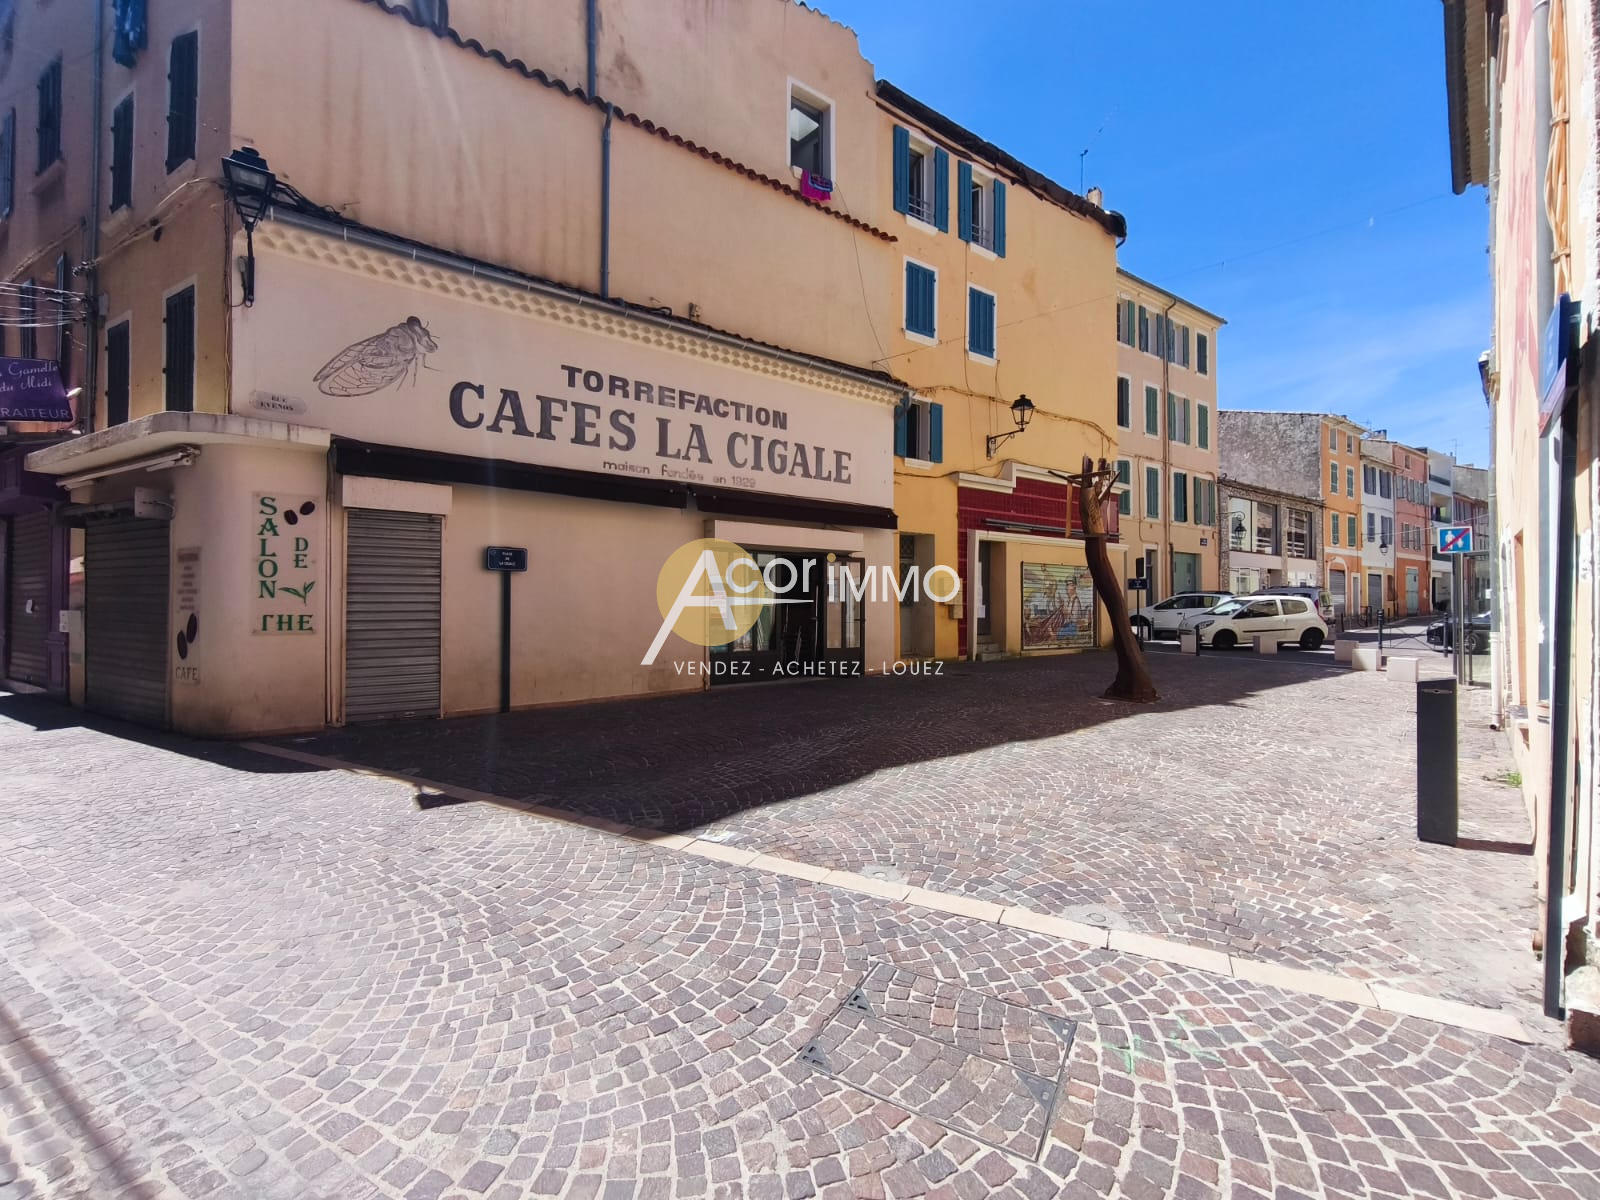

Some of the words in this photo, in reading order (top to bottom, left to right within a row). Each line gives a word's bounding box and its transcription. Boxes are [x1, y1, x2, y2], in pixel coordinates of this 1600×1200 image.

[20, 375, 52, 390] Midi
[560, 364, 788, 431] TORREFACTION
[0, 407, 70, 419] RAITEUR
[449, 381, 636, 452] CAFES
[655, 416, 713, 464] LA
[726, 431, 852, 485] CIGALE
[602, 460, 650, 475] maison
[712, 475, 727, 485] en
[256, 496, 280, 599] SALON
[293, 537, 309, 568] DE
[261, 614, 314, 632] THE
[176, 666, 198, 681] CAFE
